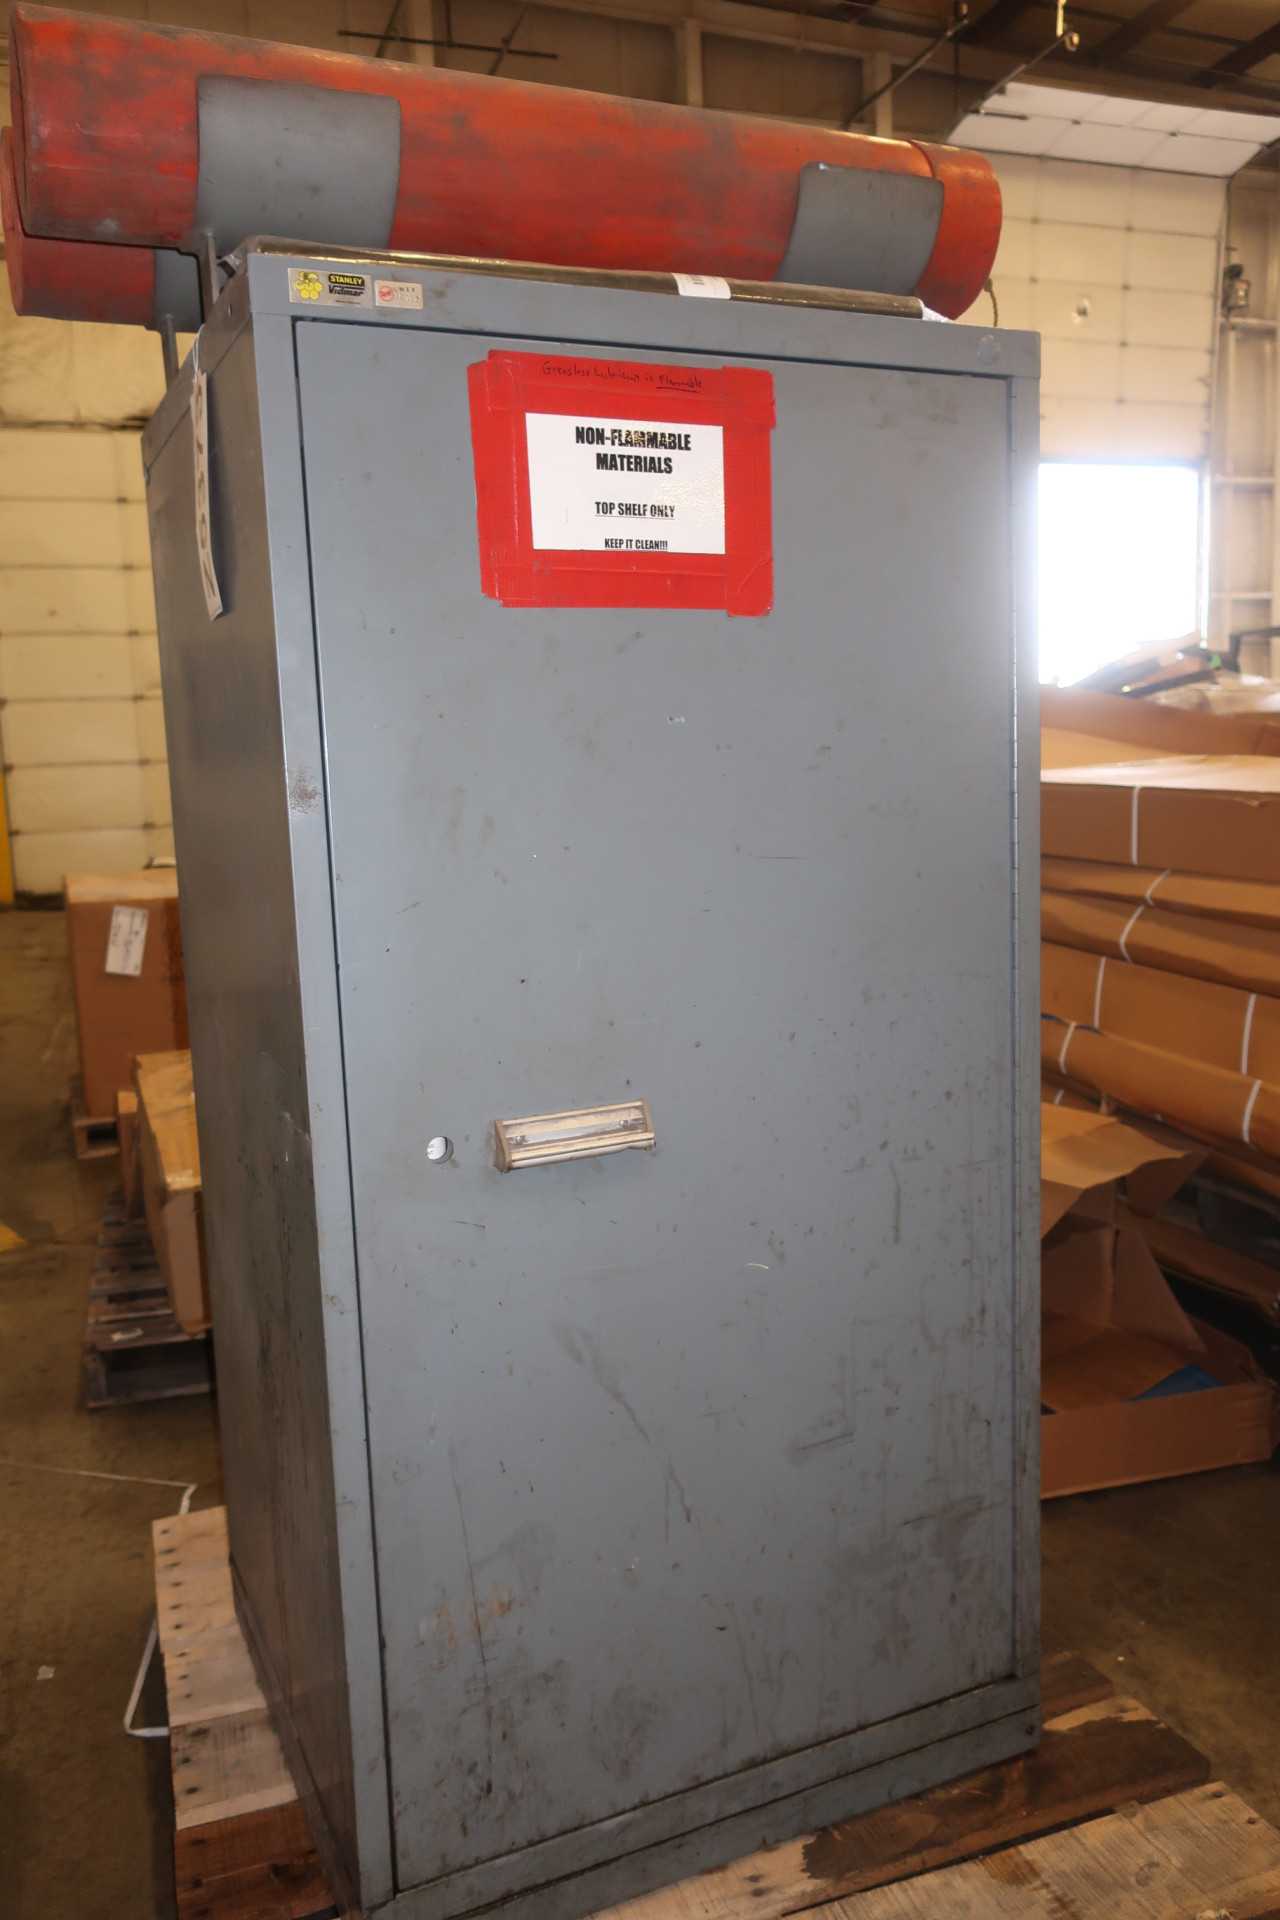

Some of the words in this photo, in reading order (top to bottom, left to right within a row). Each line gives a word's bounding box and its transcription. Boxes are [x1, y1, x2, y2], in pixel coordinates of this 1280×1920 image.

[330, 274, 363, 286] STANLEY
[328, 284, 364, 297] Vidmar
[575, 426, 692, 451] NON-FLAMMABLE
[596, 453, 673, 474] MATERIALS
[595, 501, 615, 515] TOP
[617, 502, 647, 516] SHELF
[650, 504, 675, 518] ONLY
[604, 537, 624, 549] KEEP
[625, 538, 633, 549] IT
[635, 539, 668, 550] CLEAN!!!
